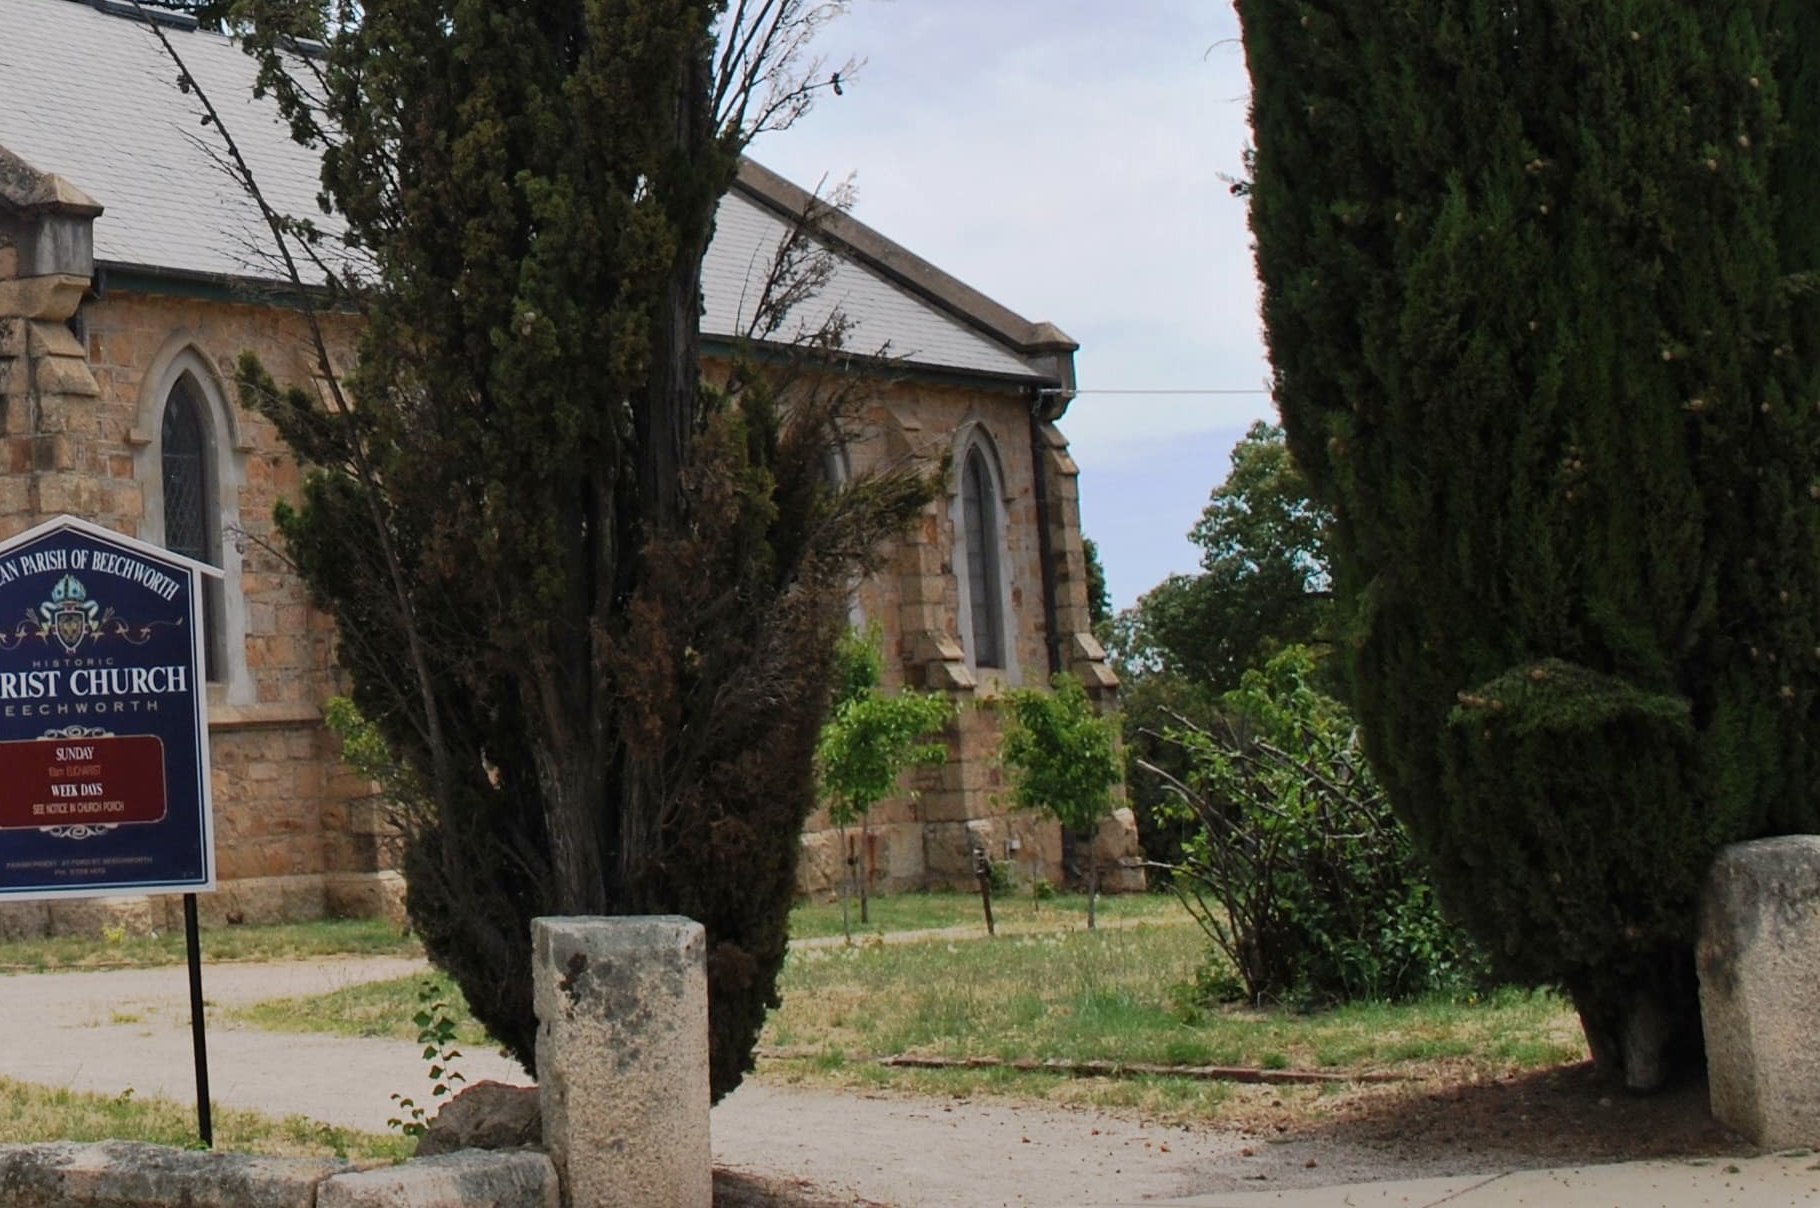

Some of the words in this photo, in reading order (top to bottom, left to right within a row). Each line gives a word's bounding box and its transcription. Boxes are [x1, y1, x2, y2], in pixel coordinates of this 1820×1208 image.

[20, 549, 67, 576] PARISH
[71, 549, 89, 569] OF
[92, 552, 180, 602] BEECHWORTH
[32, 657, 114, 668] HISTORIC
[69, 665, 188, 697] CHURCH
[56, 746, 94, 761] SUNDAY
[51, 784, 78, 797] WEEK
[81, 782, 104, 796] DAYS
[33, 803, 45, 815] SEE
[46, 802, 68, 814] NOTICE
[69, 802, 76, 813] IN
[77, 801, 102, 813] CHURCH
[103, 800, 125, 812] PORCH
